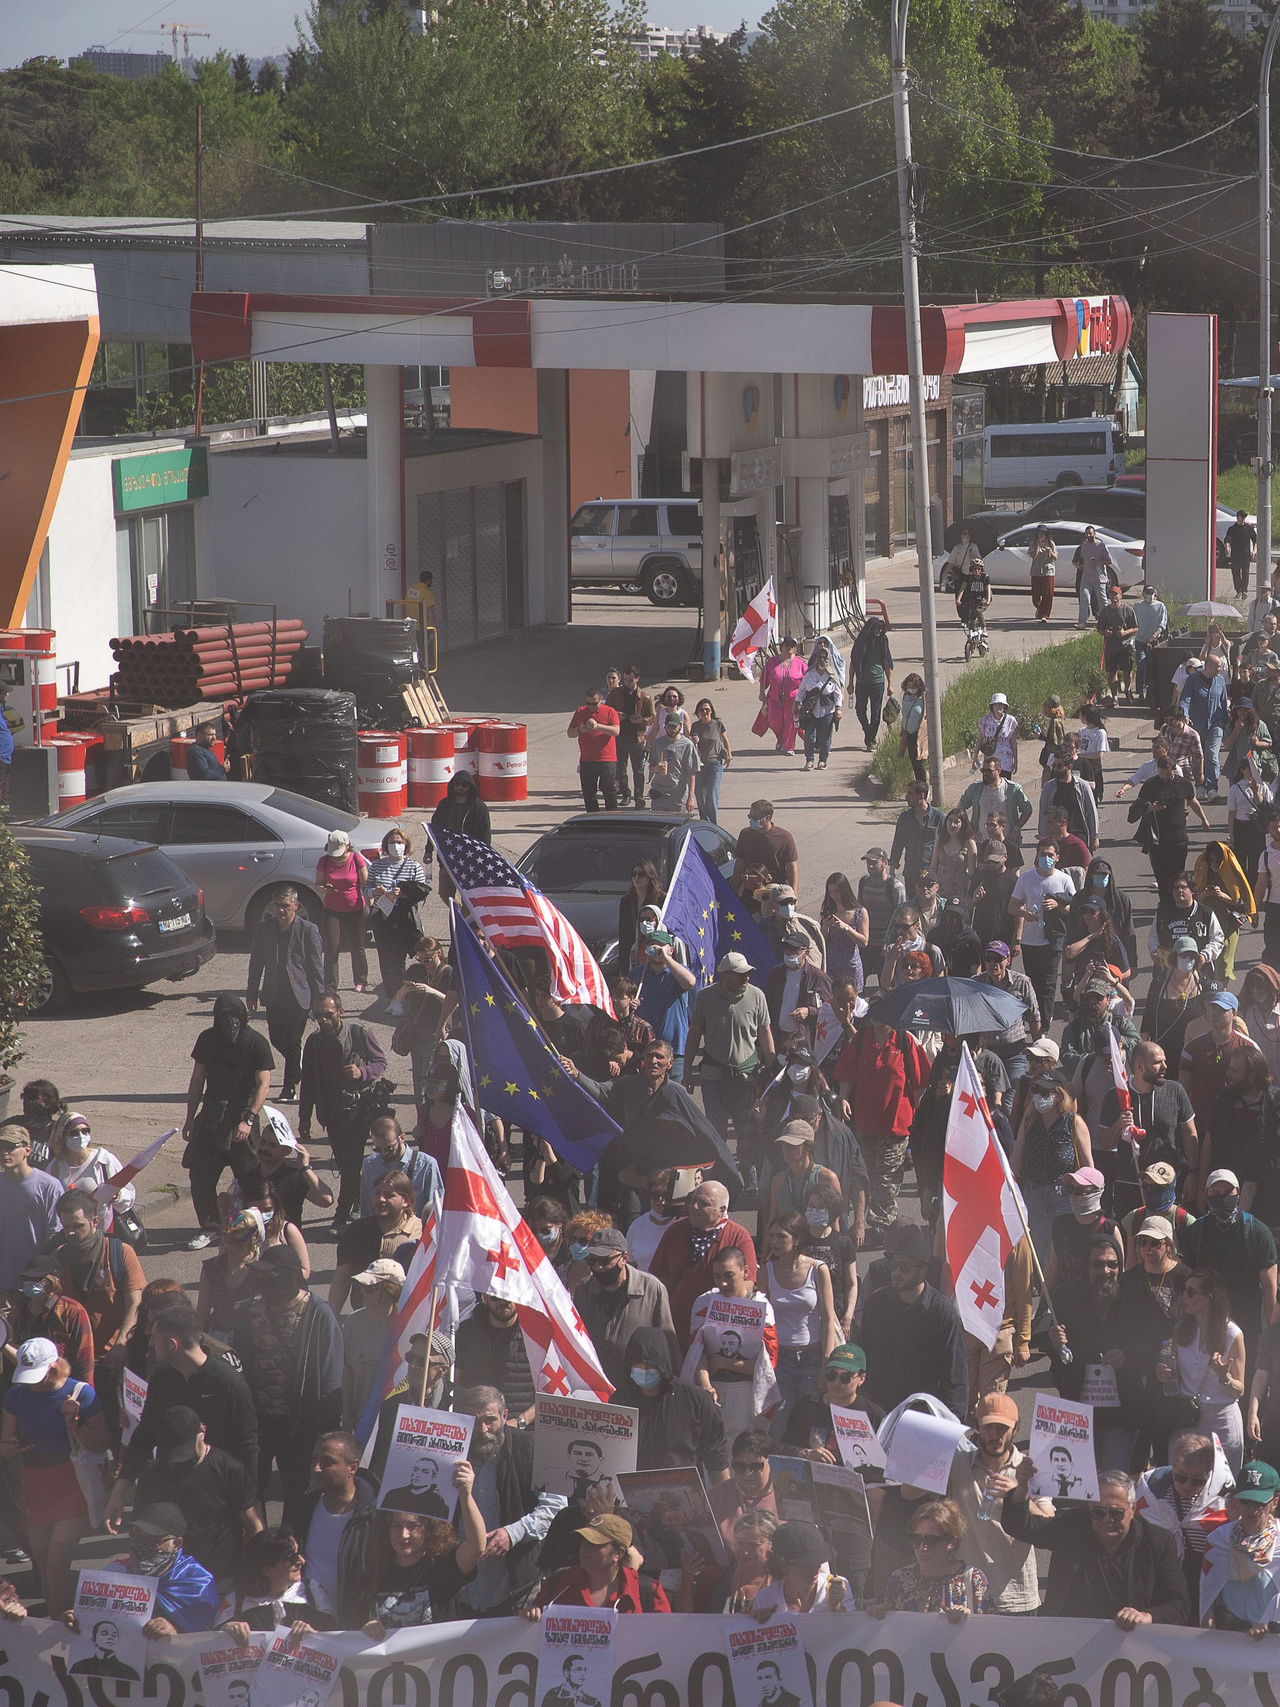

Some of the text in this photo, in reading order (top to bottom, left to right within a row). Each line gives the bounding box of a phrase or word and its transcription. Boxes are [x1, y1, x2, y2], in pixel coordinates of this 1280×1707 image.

[386, 776, 397, 784] Ofisi
[539, 1401, 634, 1428] თავისუფლება
[539, 1414, 578, 1430] ვეფხია
[1036, 1404, 1089, 1429] თავისუფლება
[399, 1416, 468, 1441] თავისუფლება
[396, 1431, 428, 1447] გიორგი
[1246, 1469, 1263, 1486] NY
[81, 1580, 151, 1603] თავისუფლება
[545, 1617, 612, 1634] თავისუფლება
[729, 1622, 797, 1647] თავისუფლება
